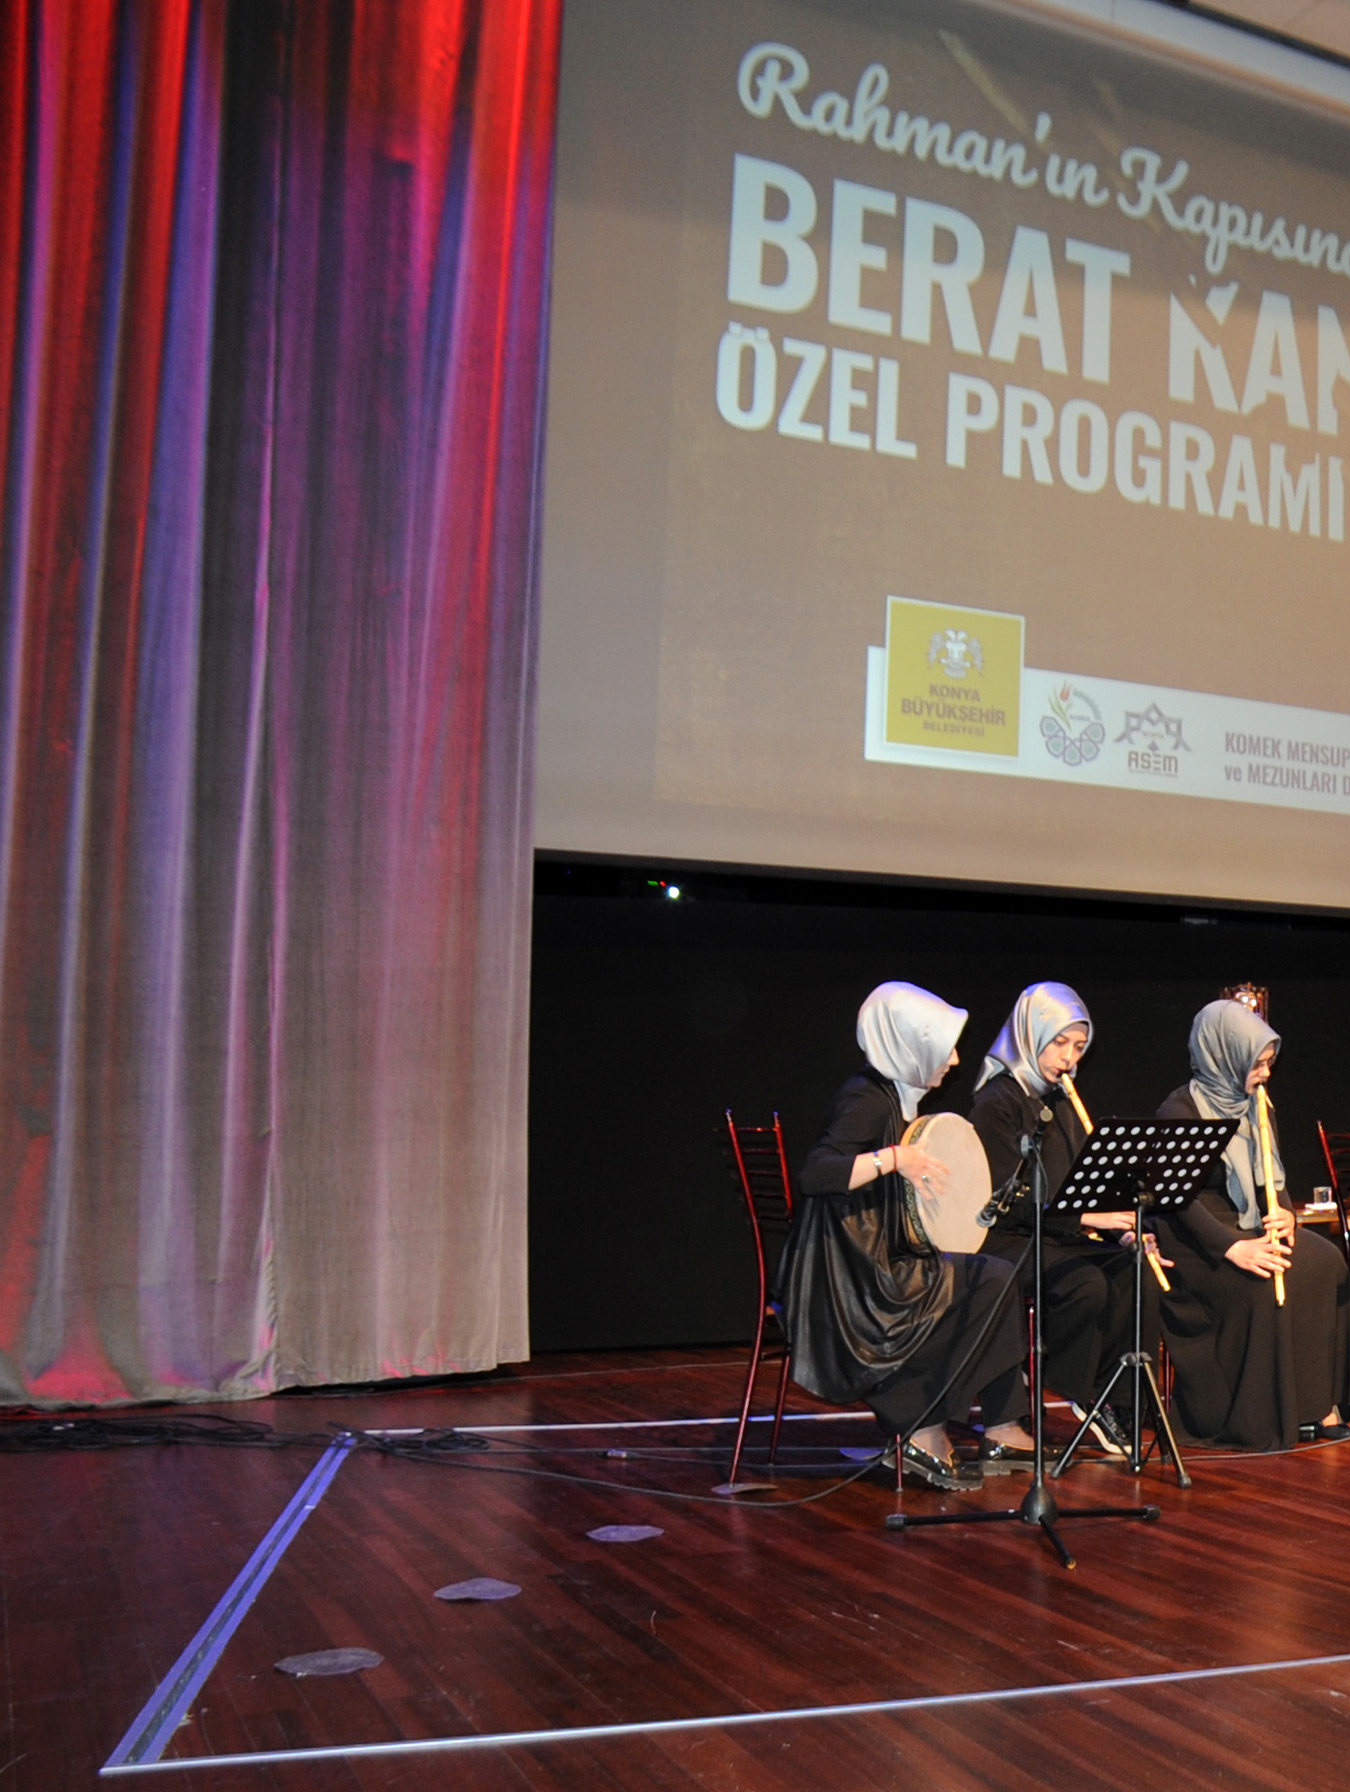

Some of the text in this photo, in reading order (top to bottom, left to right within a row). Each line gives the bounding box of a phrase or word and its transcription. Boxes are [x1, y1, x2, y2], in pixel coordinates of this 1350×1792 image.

[726, 153, 1131, 388] BERAT
[716, 322, 1345, 542] ÖZEL PROGRAMI
[929, 683, 981, 703] KONYA
[901, 695, 1006, 727] BÜYÜKŞEHİR
[1225, 731, 1282, 760] KOMEK
[1224, 764, 1242, 783] ve
[1247, 763, 1337, 794] MEZUNLARI
